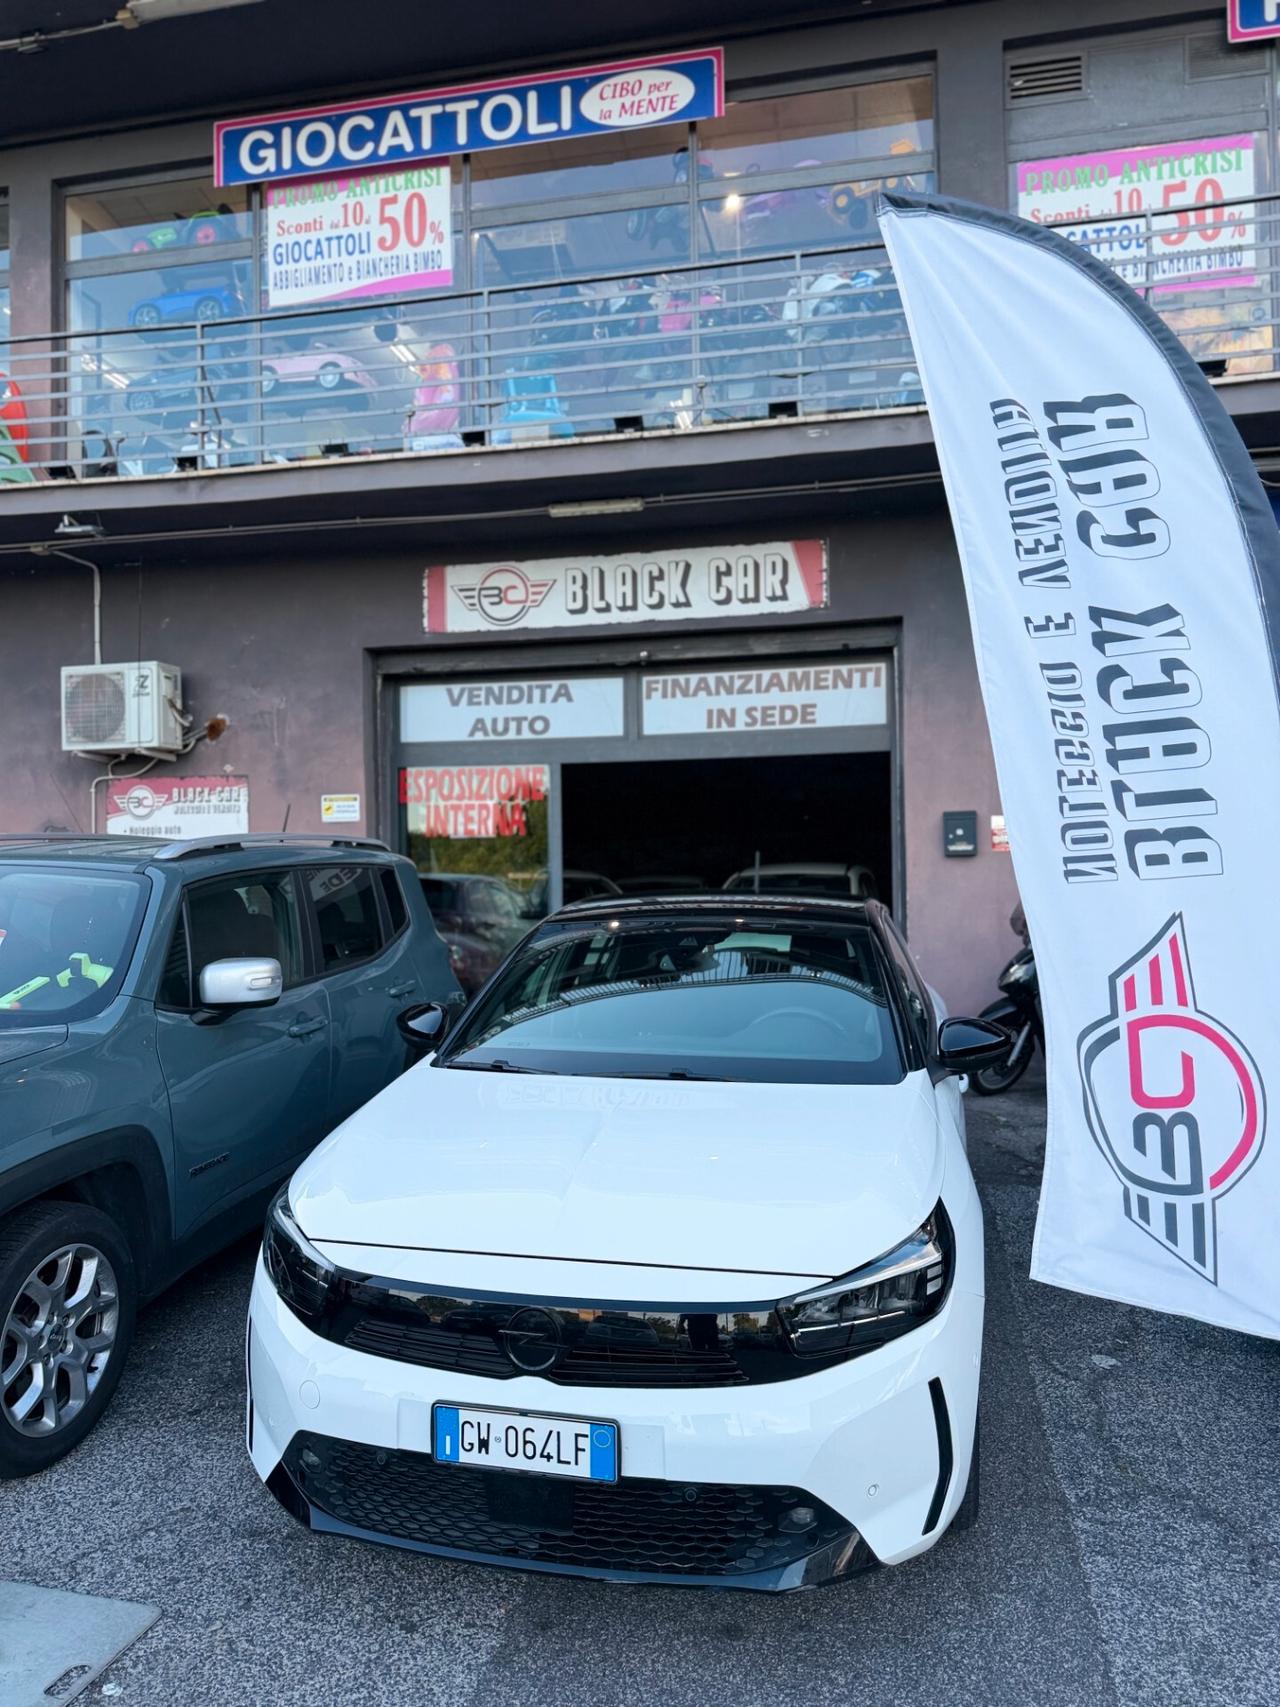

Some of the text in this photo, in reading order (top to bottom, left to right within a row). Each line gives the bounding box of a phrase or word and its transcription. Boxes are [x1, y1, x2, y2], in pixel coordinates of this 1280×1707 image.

[598, 94, 680, 120] la MENTE
[599, 79, 672, 101] CIBO per
[239, 85, 572, 175] GIOCATTOLI
[273, 167, 443, 209] PROMO ANTICRISI
[1025, 148, 1243, 196] PROMO ANTICRISI
[276, 215, 323, 237] Sconti
[342, 201, 364, 228] 10
[1114, 188, 1143, 215] 10
[273, 231, 371, 266] GIOCATTOLI
[273, 263, 344, 290] ABBIGLIAMENTO
[356, 254, 411, 281] BIANCHERIA
[414, 249, 443, 273] BIMBO
[565, 560, 692, 615] BLACK
[708, 553, 790, 605] CAR
[446, 683, 574, 708] VENDITA
[645, 666, 883, 700] FINANZIAMENTI
[468, 715, 551, 738] AUTO
[706, 703, 818, 729] IN SEDE
[400, 766, 545, 804] ESPOSIZIONE
[425, 803, 527, 837] INTERNA
[461, 1421, 589, 1466] GW 064LF
